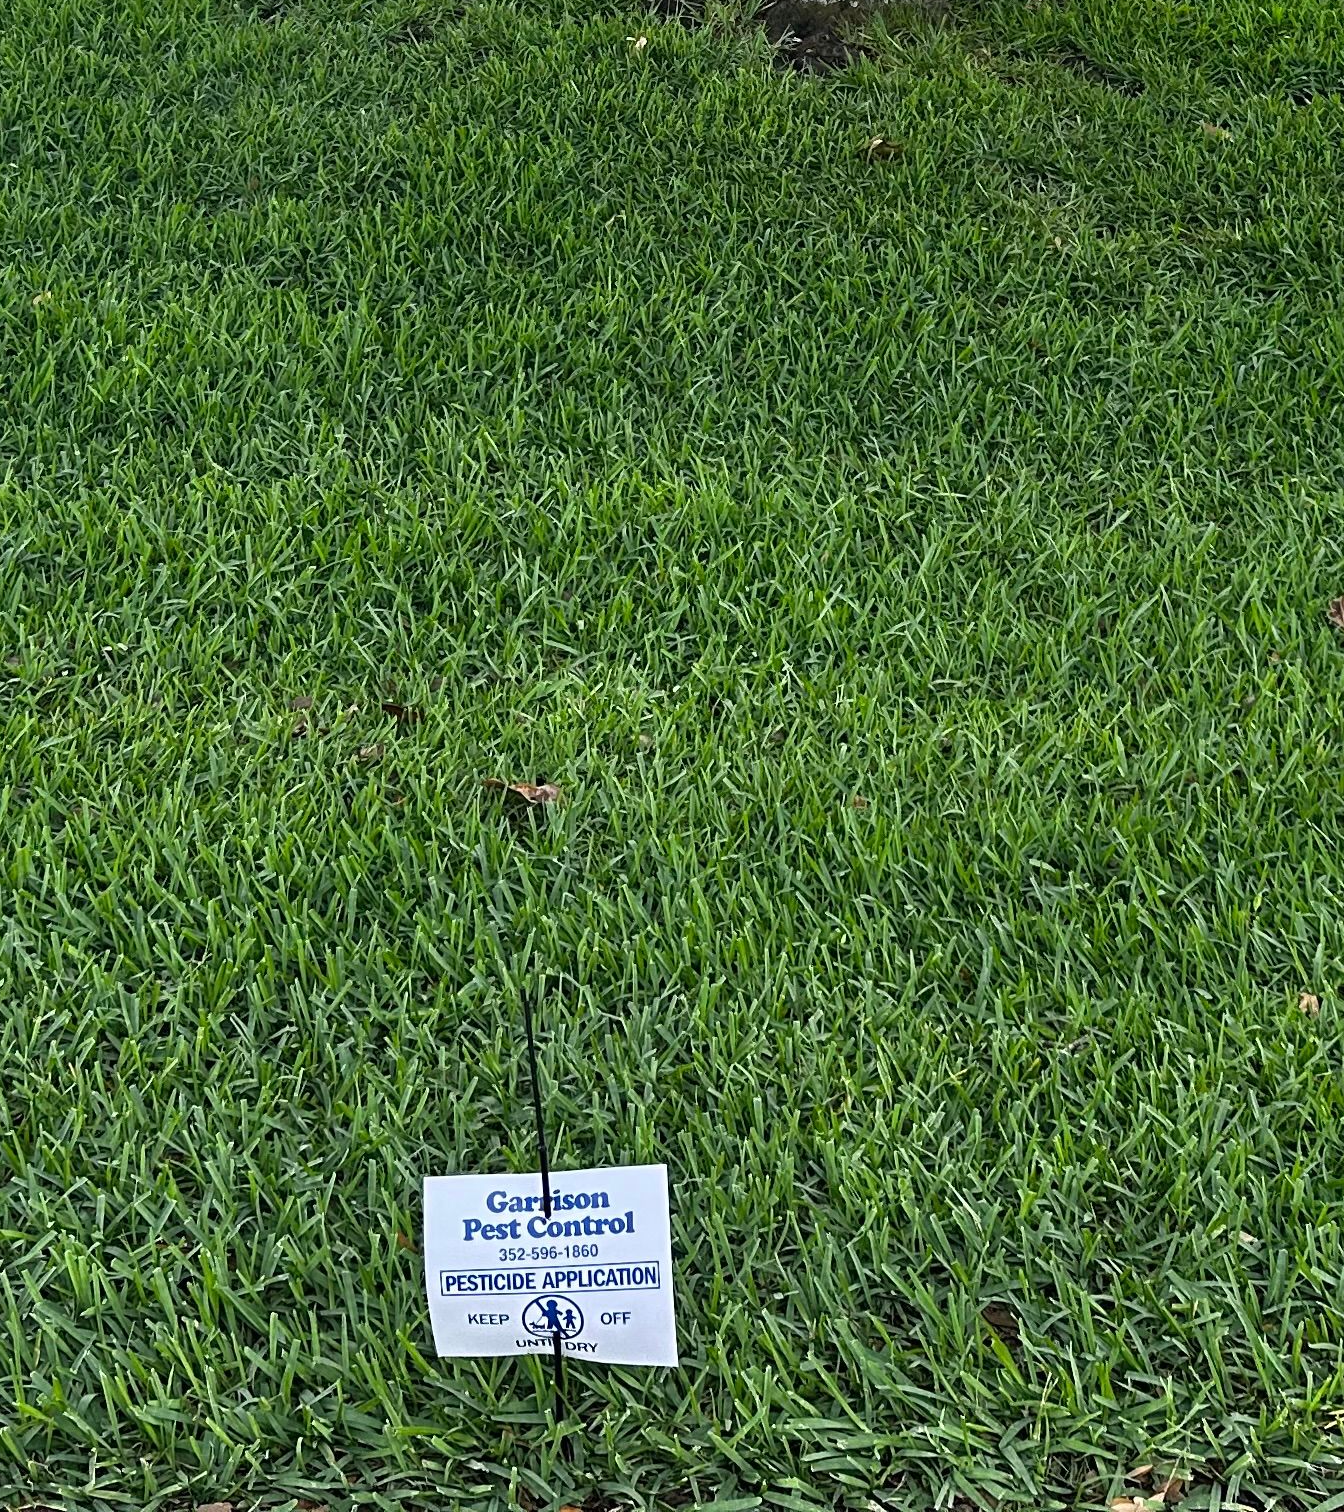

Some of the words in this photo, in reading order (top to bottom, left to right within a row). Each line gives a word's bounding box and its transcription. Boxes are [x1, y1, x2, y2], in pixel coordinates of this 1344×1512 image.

[486, 1189, 610, 1214] Garrison
[463, 1219, 521, 1241] Pest
[527, 1211, 635, 1239] Control
[499, 1244, 599, 1262] 352-596-1860
[445, 1272, 536, 1292] PESTICIDE
[542, 1266, 657, 1289] APPLICATION
[468, 1313, 510, 1325] KEEP
[600, 1312, 632, 1326] OFF
[516, 1338, 555, 1348] UNTI
[565, 1341, 599, 1353] DRY
